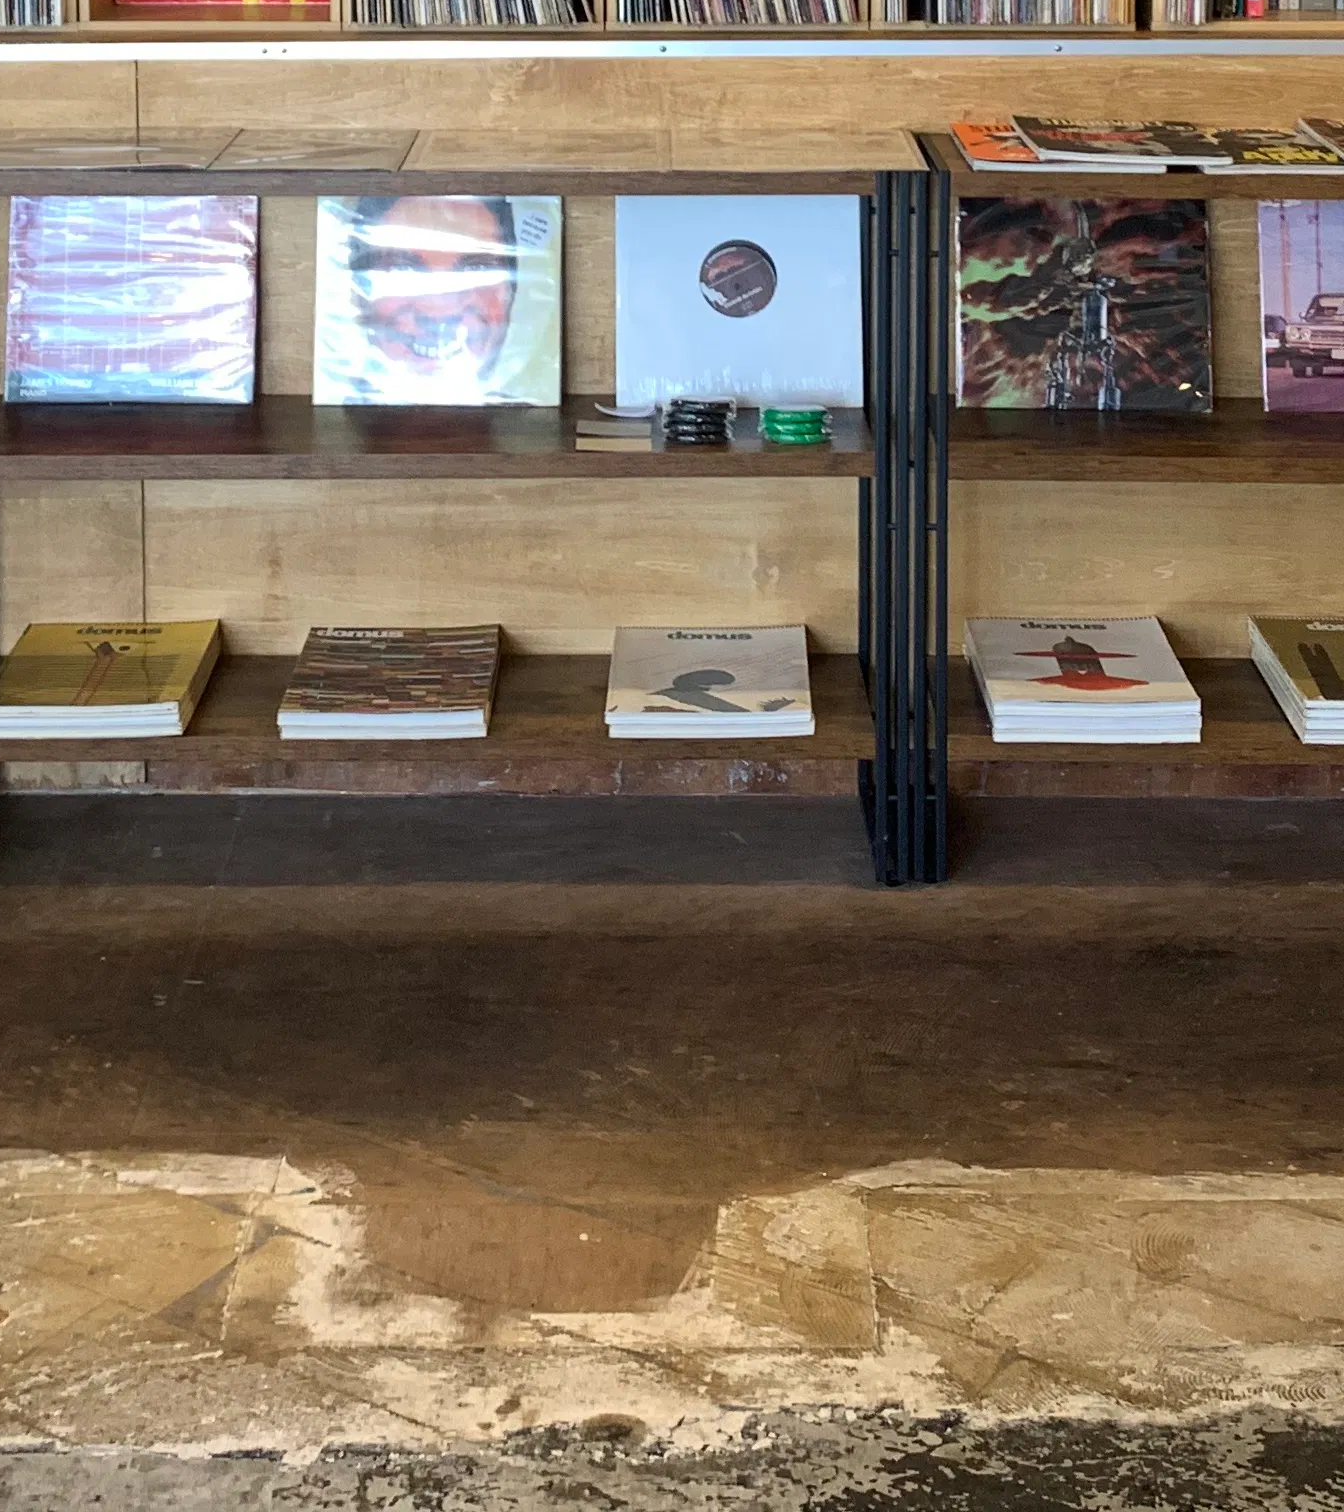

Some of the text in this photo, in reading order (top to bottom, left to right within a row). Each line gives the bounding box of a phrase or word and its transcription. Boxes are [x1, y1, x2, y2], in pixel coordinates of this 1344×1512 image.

[76, 625, 163, 636] domus
[1019, 621, 1107, 631] domus
[316, 626, 405, 639] domus
[667, 631, 753, 641] domus
